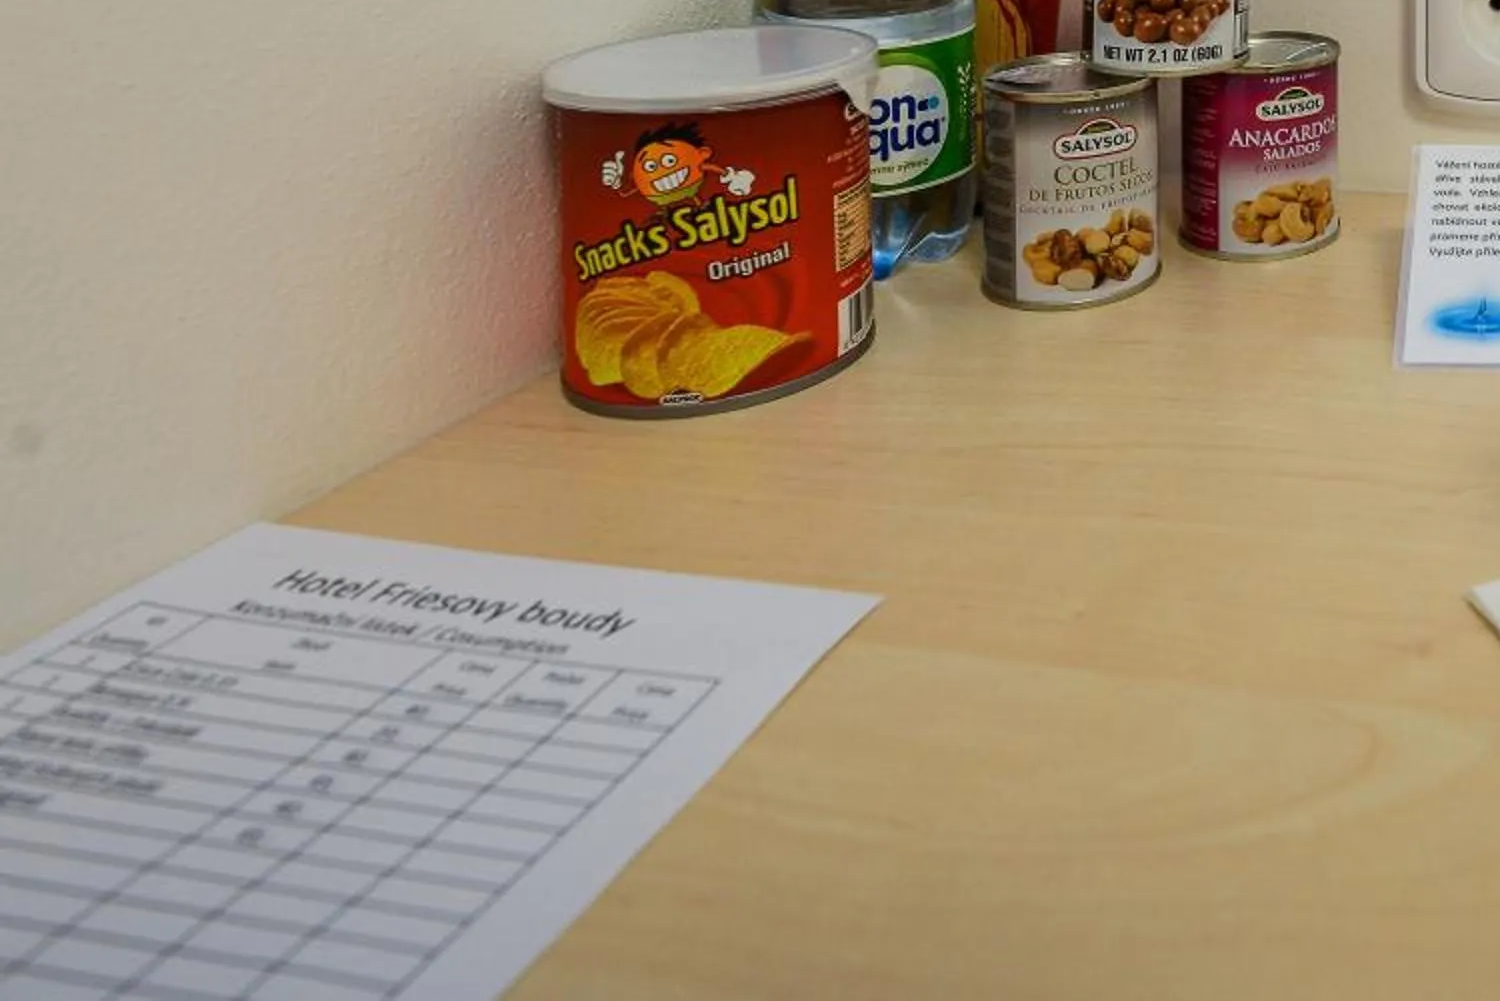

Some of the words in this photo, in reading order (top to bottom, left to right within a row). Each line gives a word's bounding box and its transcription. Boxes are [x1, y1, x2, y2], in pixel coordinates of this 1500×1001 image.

[1104, 45, 1121, 60] NET
[1125, 48, 1144, 62] WT
[1147, 48, 1168, 63] 2.1
[1173, 48, 1188, 62] OZ
[1260, 98, 1321, 116] SALYSOL
[1061, 132, 1132, 153] SALYSOL
[1263, 141, 1321, 160] SALADOS
[1054, 156, 1135, 186] COCTEL
[1029, 189, 1049, 202] DE
[1055, 182, 1116, 202] FRUTOS
[575, 223, 670, 281] Snacks
[672, 177, 799, 246] Salysol
[708, 241, 792, 281] Original
[272, 569, 379, 600] Hotel
[369, 581, 520, 623] Friesovy
[517, 599, 638, 639] boudy
